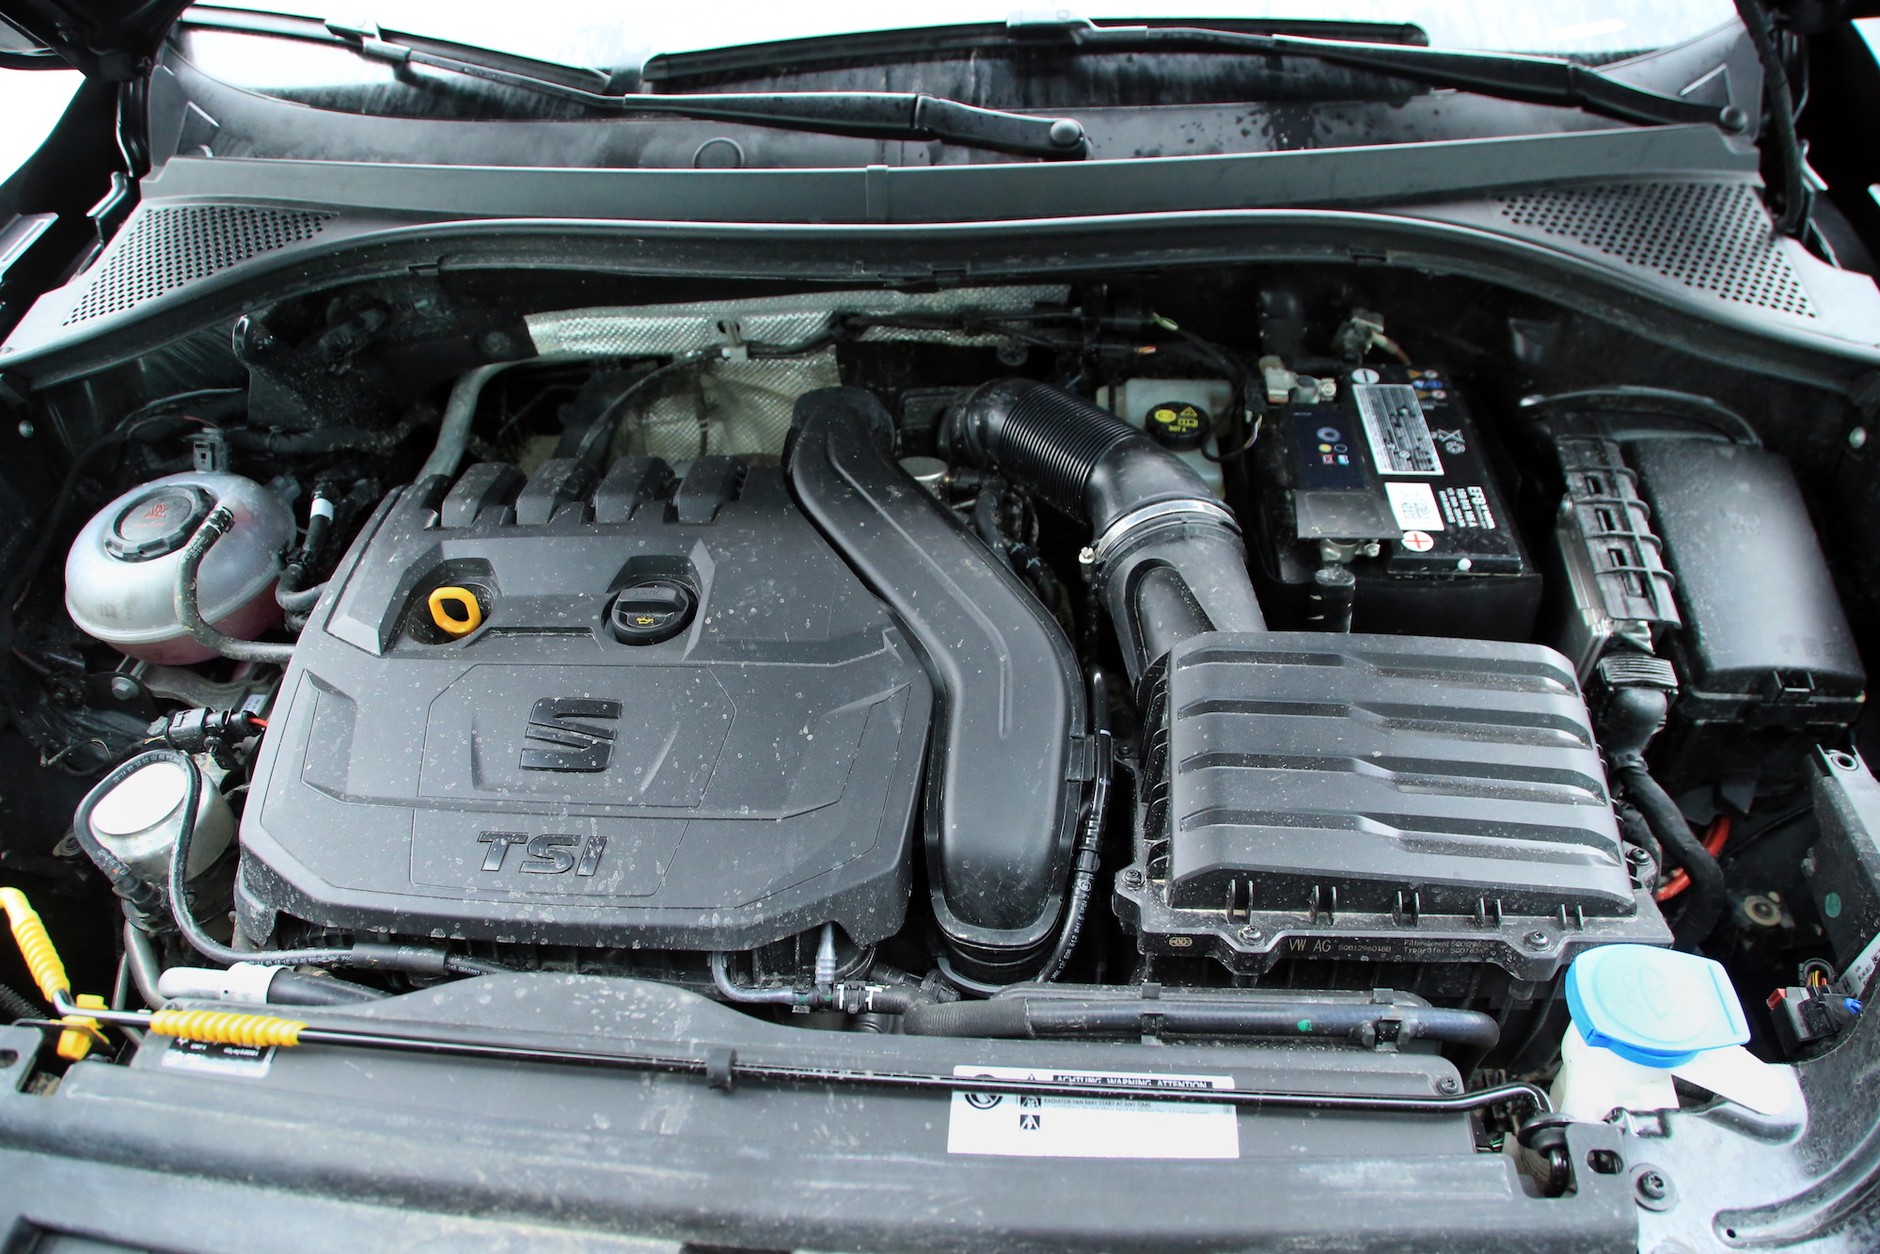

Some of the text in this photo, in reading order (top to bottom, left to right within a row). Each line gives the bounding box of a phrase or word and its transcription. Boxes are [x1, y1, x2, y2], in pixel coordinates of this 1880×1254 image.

[1467, 486, 1487, 505] EFB
[477, 830, 608, 877] TSI
[1289, 938, 1332, 953] VW AG
[1107, 1078, 1152, 1086] WARNING
[1156, 1080, 1208, 1089] ATTENTION
